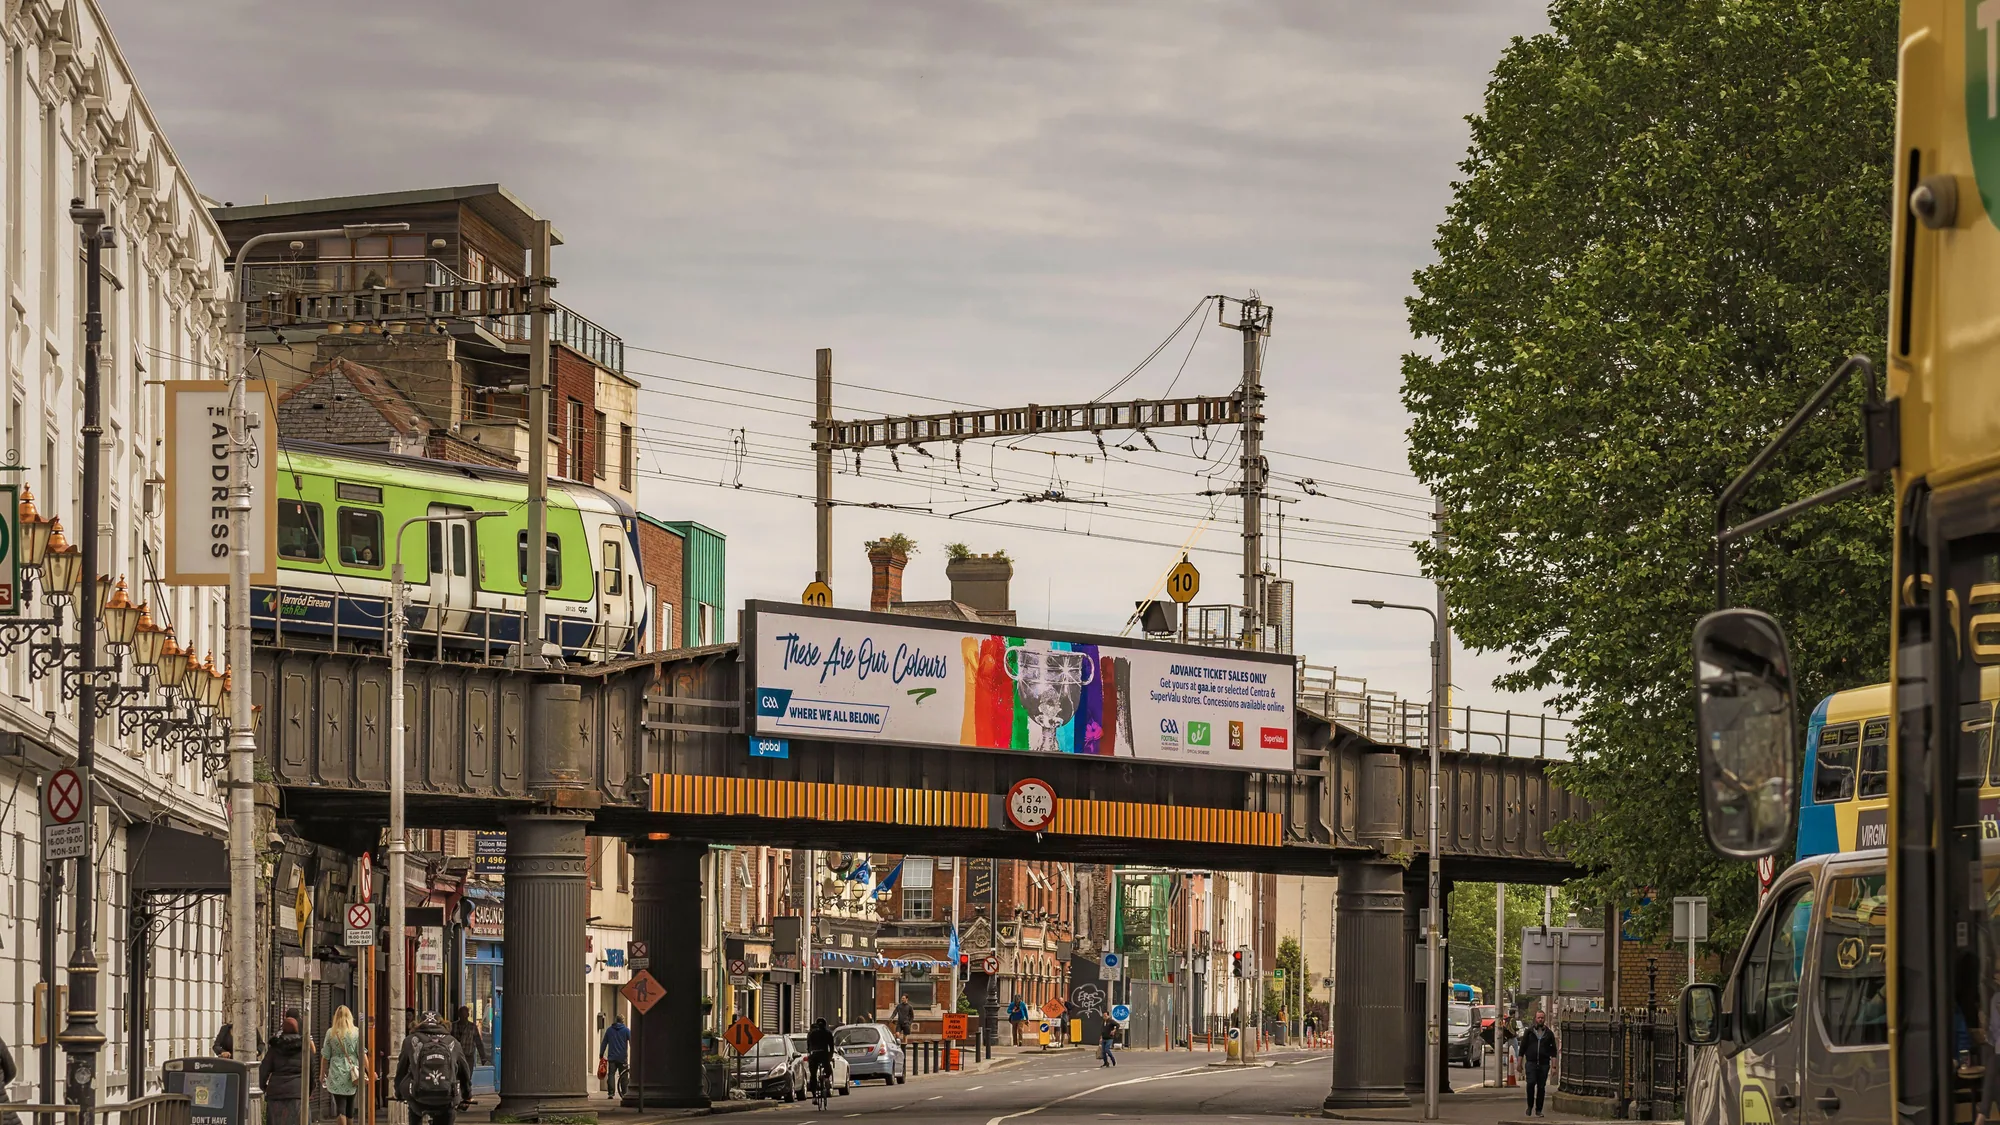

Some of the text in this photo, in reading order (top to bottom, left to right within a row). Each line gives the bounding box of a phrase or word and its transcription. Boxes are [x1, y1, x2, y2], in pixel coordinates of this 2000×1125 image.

[207, 407, 230, 416] TH
[211, 422, 229, 558] ADDRESS
[1173, 573, 1192, 592] 10
[807, 592, 826, 606] 10
[280, 604, 308, 616] rish Rail
[776, 632, 947, 684] These Are Our Colours
[1170, 664, 1267, 684] ADVANCE TICKET SALES ONLY
[1160, 678, 1276, 698] Get yours at gaa.ie or selected Centra &
[1150, 690, 1285, 712] SuperValu stores. Concessions available online
[789, 706, 880, 725] WHERE WE ALL BELONG
[1231, 738, 1241, 747] AIB
[1263, 734, 1285, 744] SuperValu
[759, 740, 780, 754] global
[1017, 805, 1047, 814] 4.69m
[51, 826, 80, 837] Luan-Sath
[51, 846, 80, 856] MON-SAT
[476, 906, 498, 924] SAIGON
[1001, 926, 1012, 936] 47
[212, 1117, 228, 1125] HAVE
